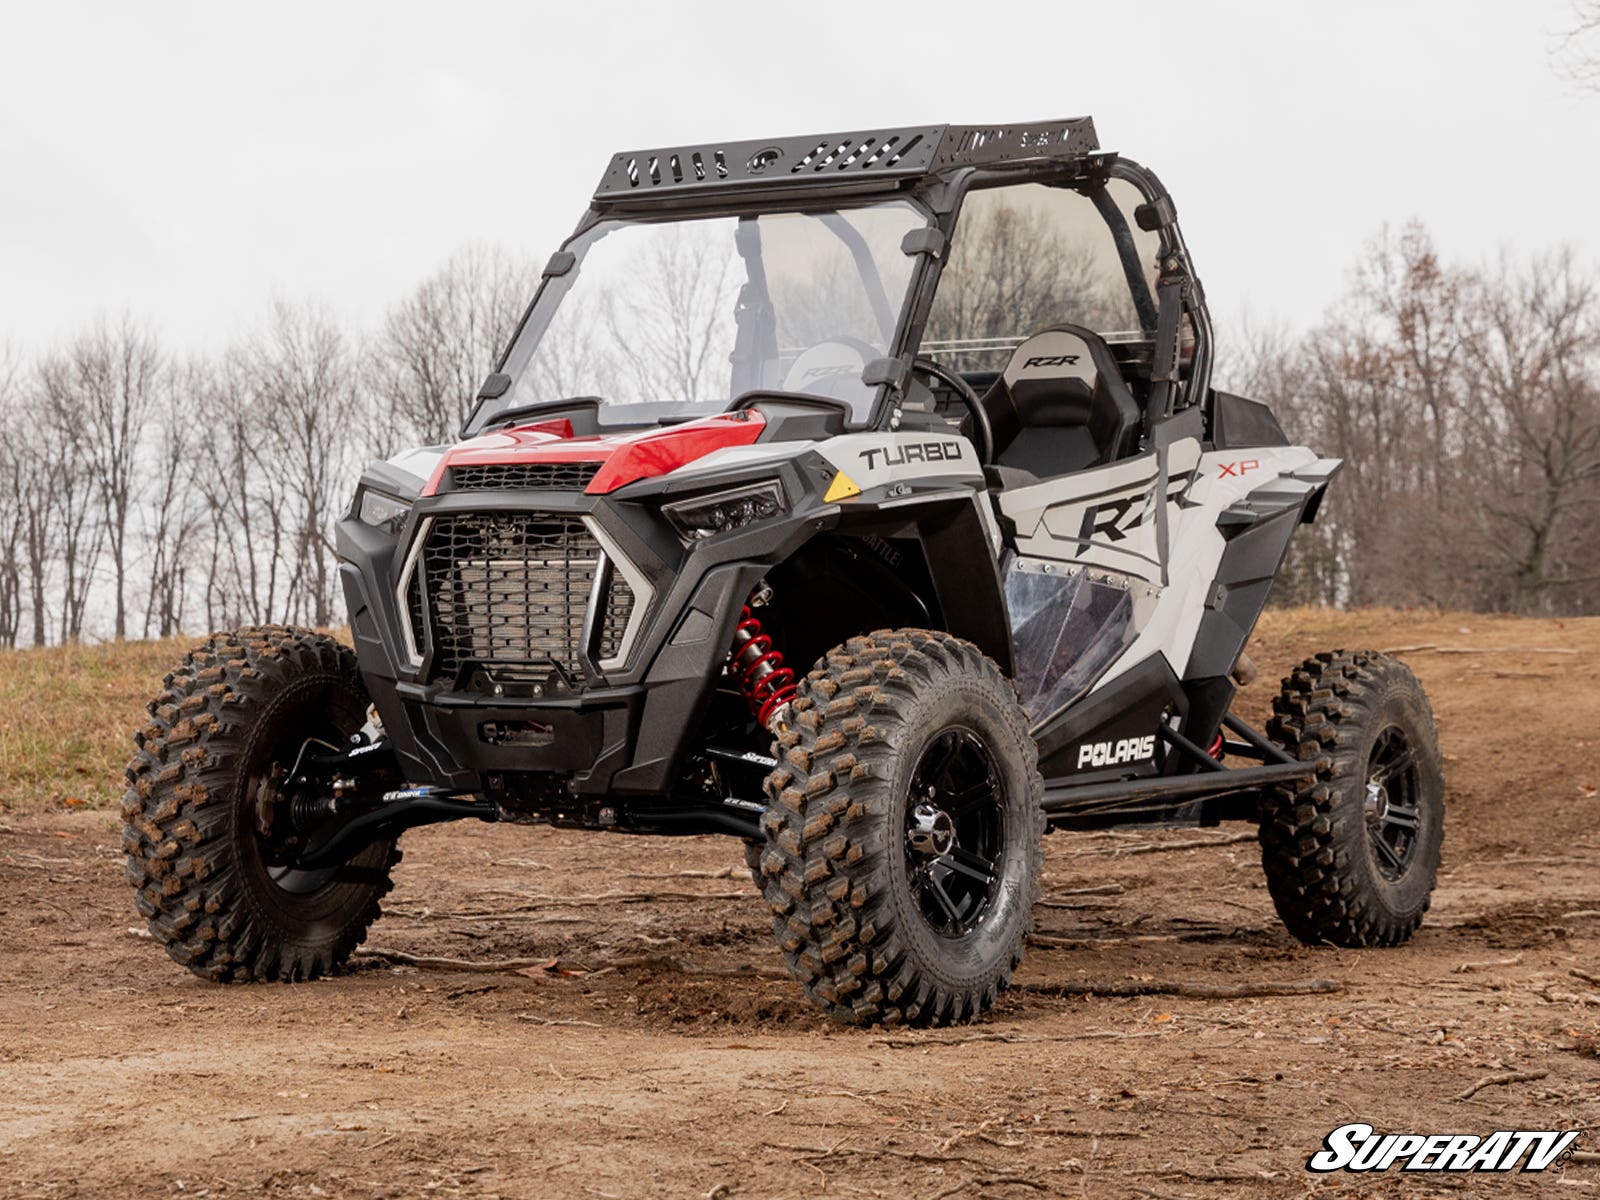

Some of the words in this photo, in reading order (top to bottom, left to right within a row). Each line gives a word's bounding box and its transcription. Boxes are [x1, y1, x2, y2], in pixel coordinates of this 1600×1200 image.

[1022, 354, 1081, 370] RZR
[858, 441, 963, 471] TURBO
[1217, 459, 1260, 480] XP
[1077, 734, 1156, 769] POLARIS
